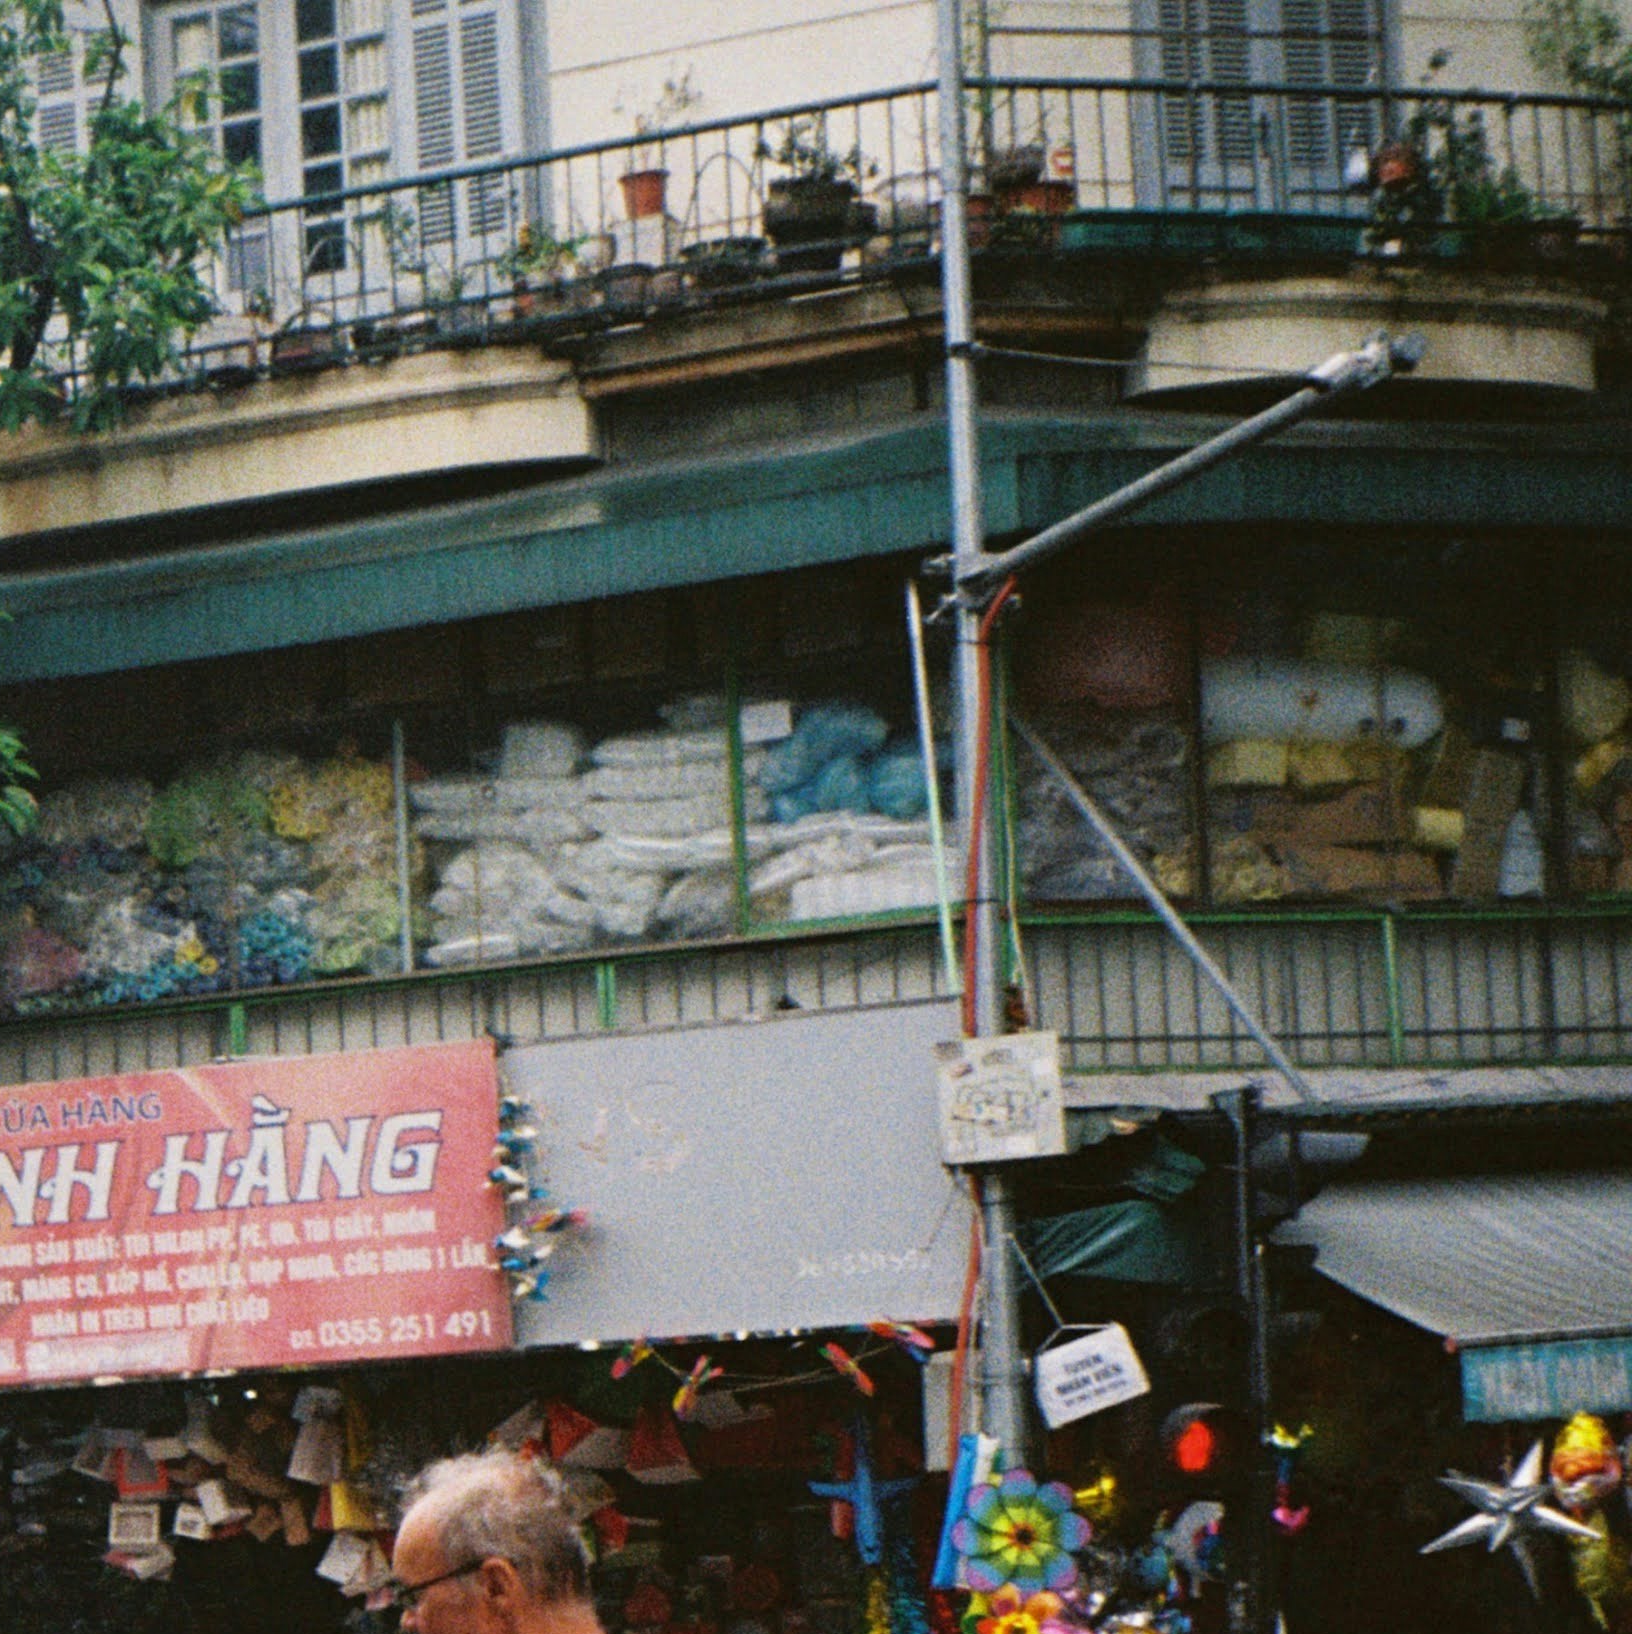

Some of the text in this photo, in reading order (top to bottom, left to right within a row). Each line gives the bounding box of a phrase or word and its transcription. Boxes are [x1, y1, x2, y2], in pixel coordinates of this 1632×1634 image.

[61, 1092, 162, 1127] HÀNG
[146, 1093, 443, 1216] HẰNG
[318, 1318, 384, 1348] 0355
[389, 1312, 436, 1342] 251
[444, 1309, 492, 1338] 491
